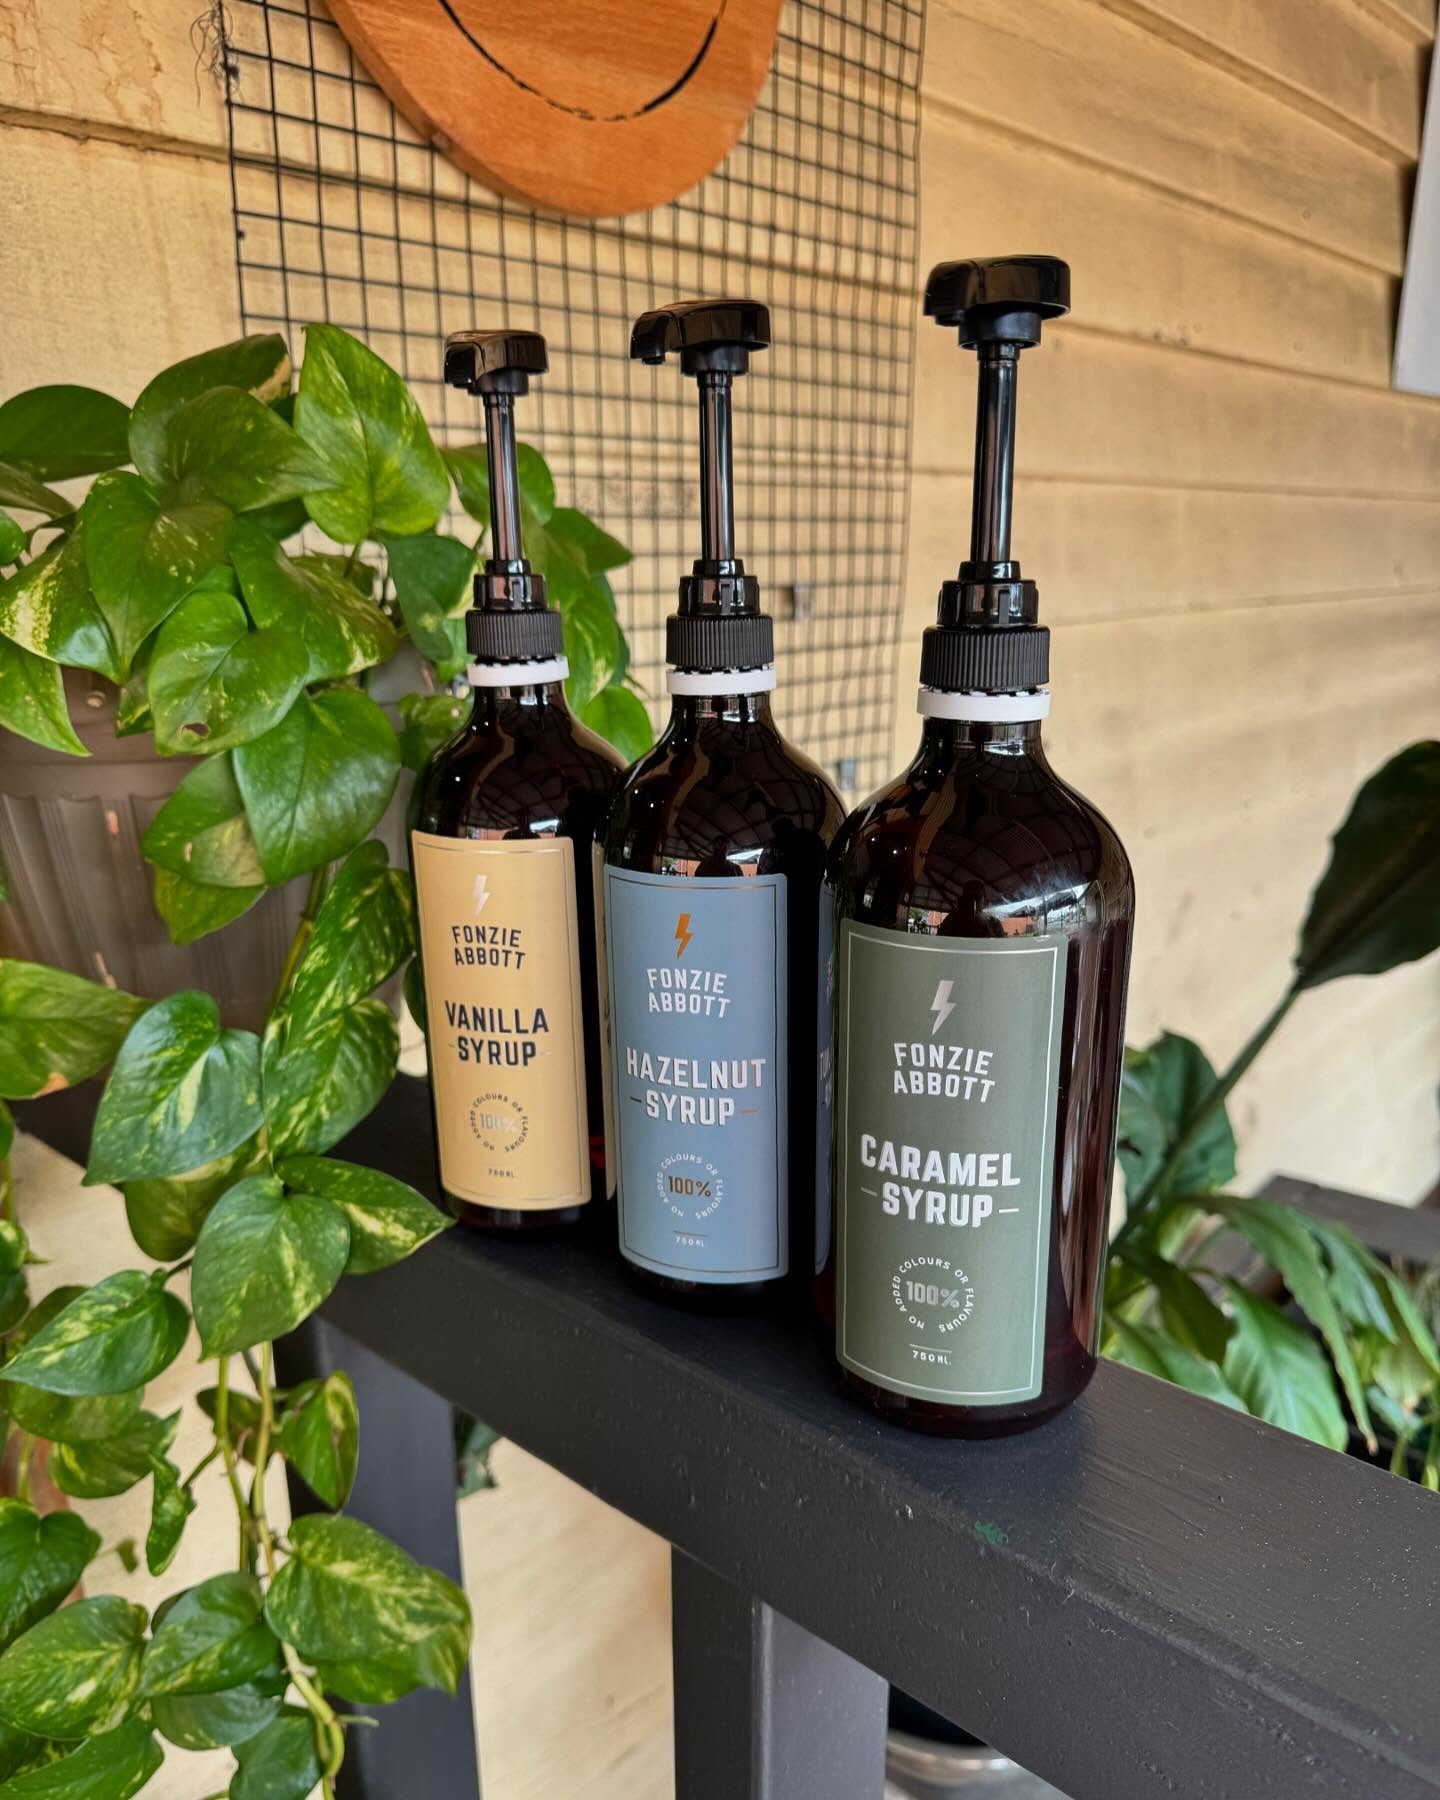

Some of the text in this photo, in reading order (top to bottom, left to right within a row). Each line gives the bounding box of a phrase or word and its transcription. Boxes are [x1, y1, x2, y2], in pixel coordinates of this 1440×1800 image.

[452, 925, 522, 948] FONZIE
[454, 947, 526, 970] ABBOTT
[647, 968, 727, 995] FONZIE
[445, 1000, 550, 1034] VANILLA
[648, 991, 731, 1018] ABBOTT
[457, 1036, 537, 1066] SYRUP
[893, 1042, 994, 1076] FONZIE
[626, 1047, 766, 1090] HAZELNUT
[893, 1070, 996, 1104] ABBOTT
[646, 1090, 735, 1126] SYRUP
[860, 1133, 1021, 1188] CARAMEL
[656, 1153, 723, 1219] NO ADDED COLOURS OR FLAVOURS
[668, 1175, 712, 1197] 100%
[881, 1181, 994, 1229] SYRUP
[892, 1257, 975, 1333] NO ADDED COLOURS OR FLAVOURS
[905, 1280, 960, 1308] 100%
